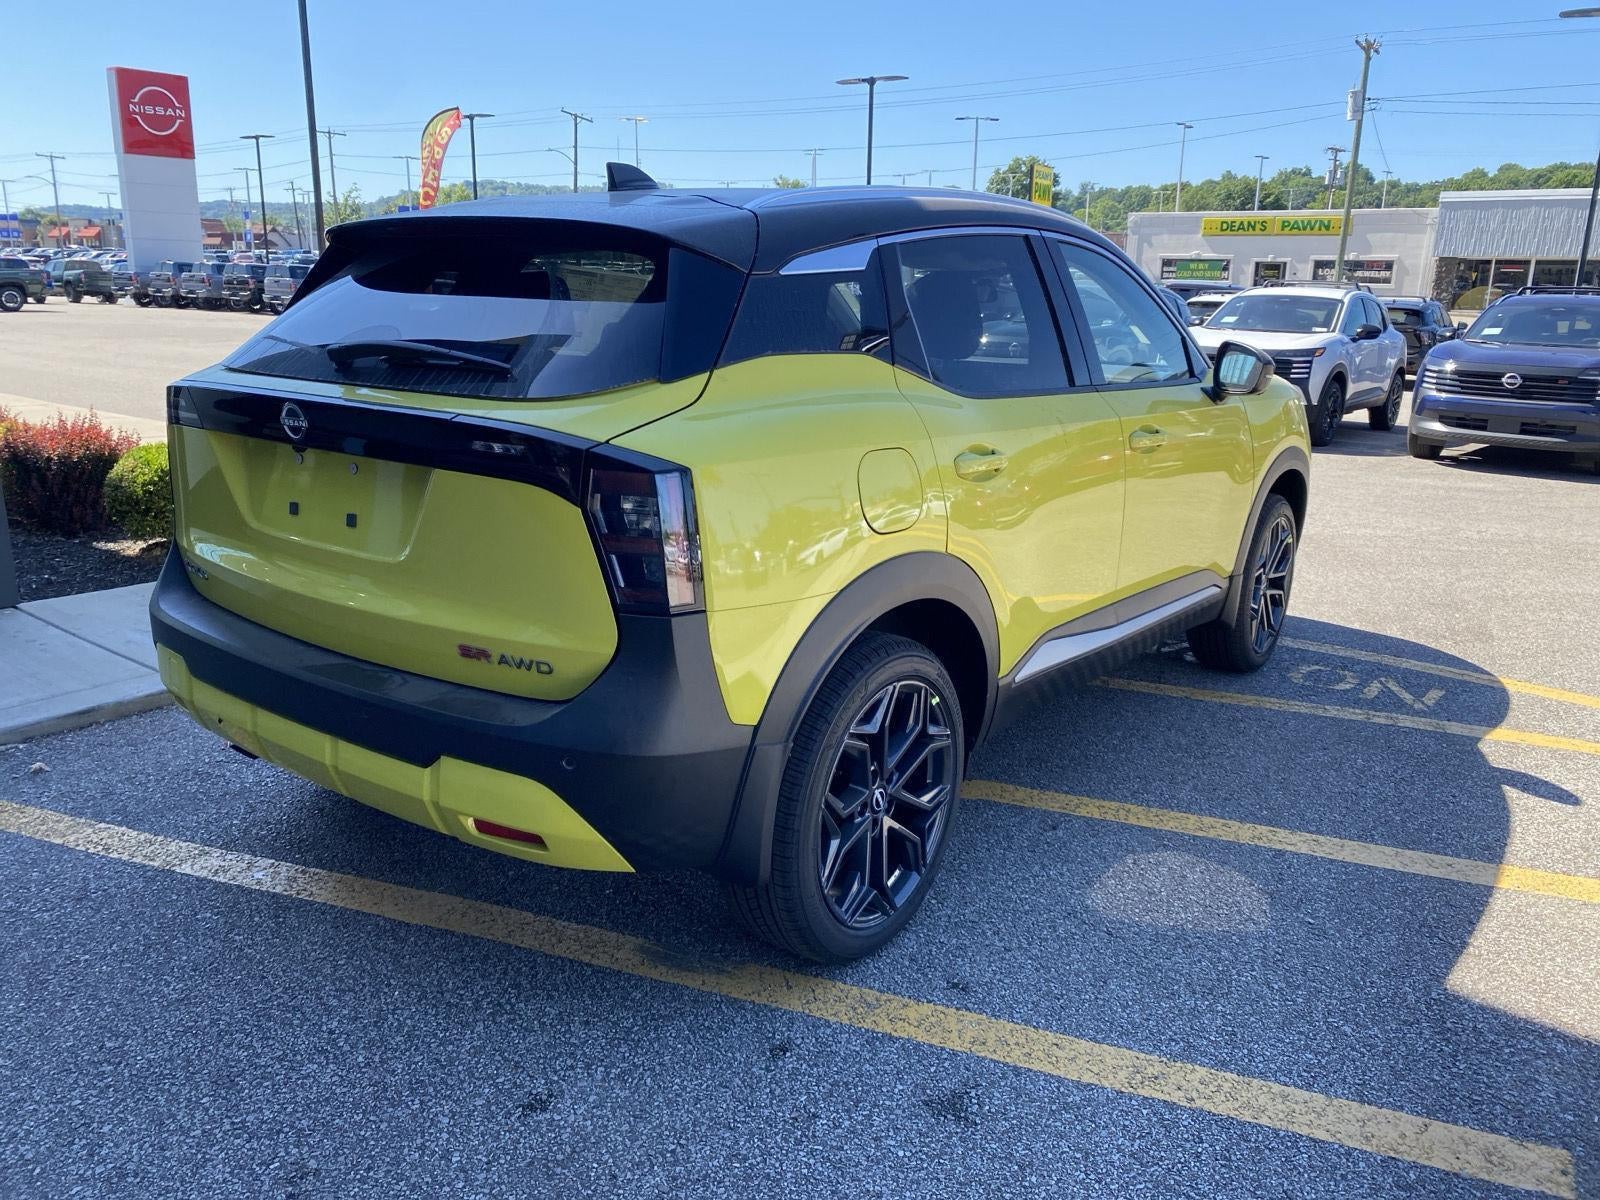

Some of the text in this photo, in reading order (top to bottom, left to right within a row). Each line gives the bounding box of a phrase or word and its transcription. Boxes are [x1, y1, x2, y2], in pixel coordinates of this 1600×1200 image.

[129, 104, 185, 117] NISSAN
[1220, 219, 1332, 232] DEAN'S PAWN
[498, 653, 554, 676] AWD
